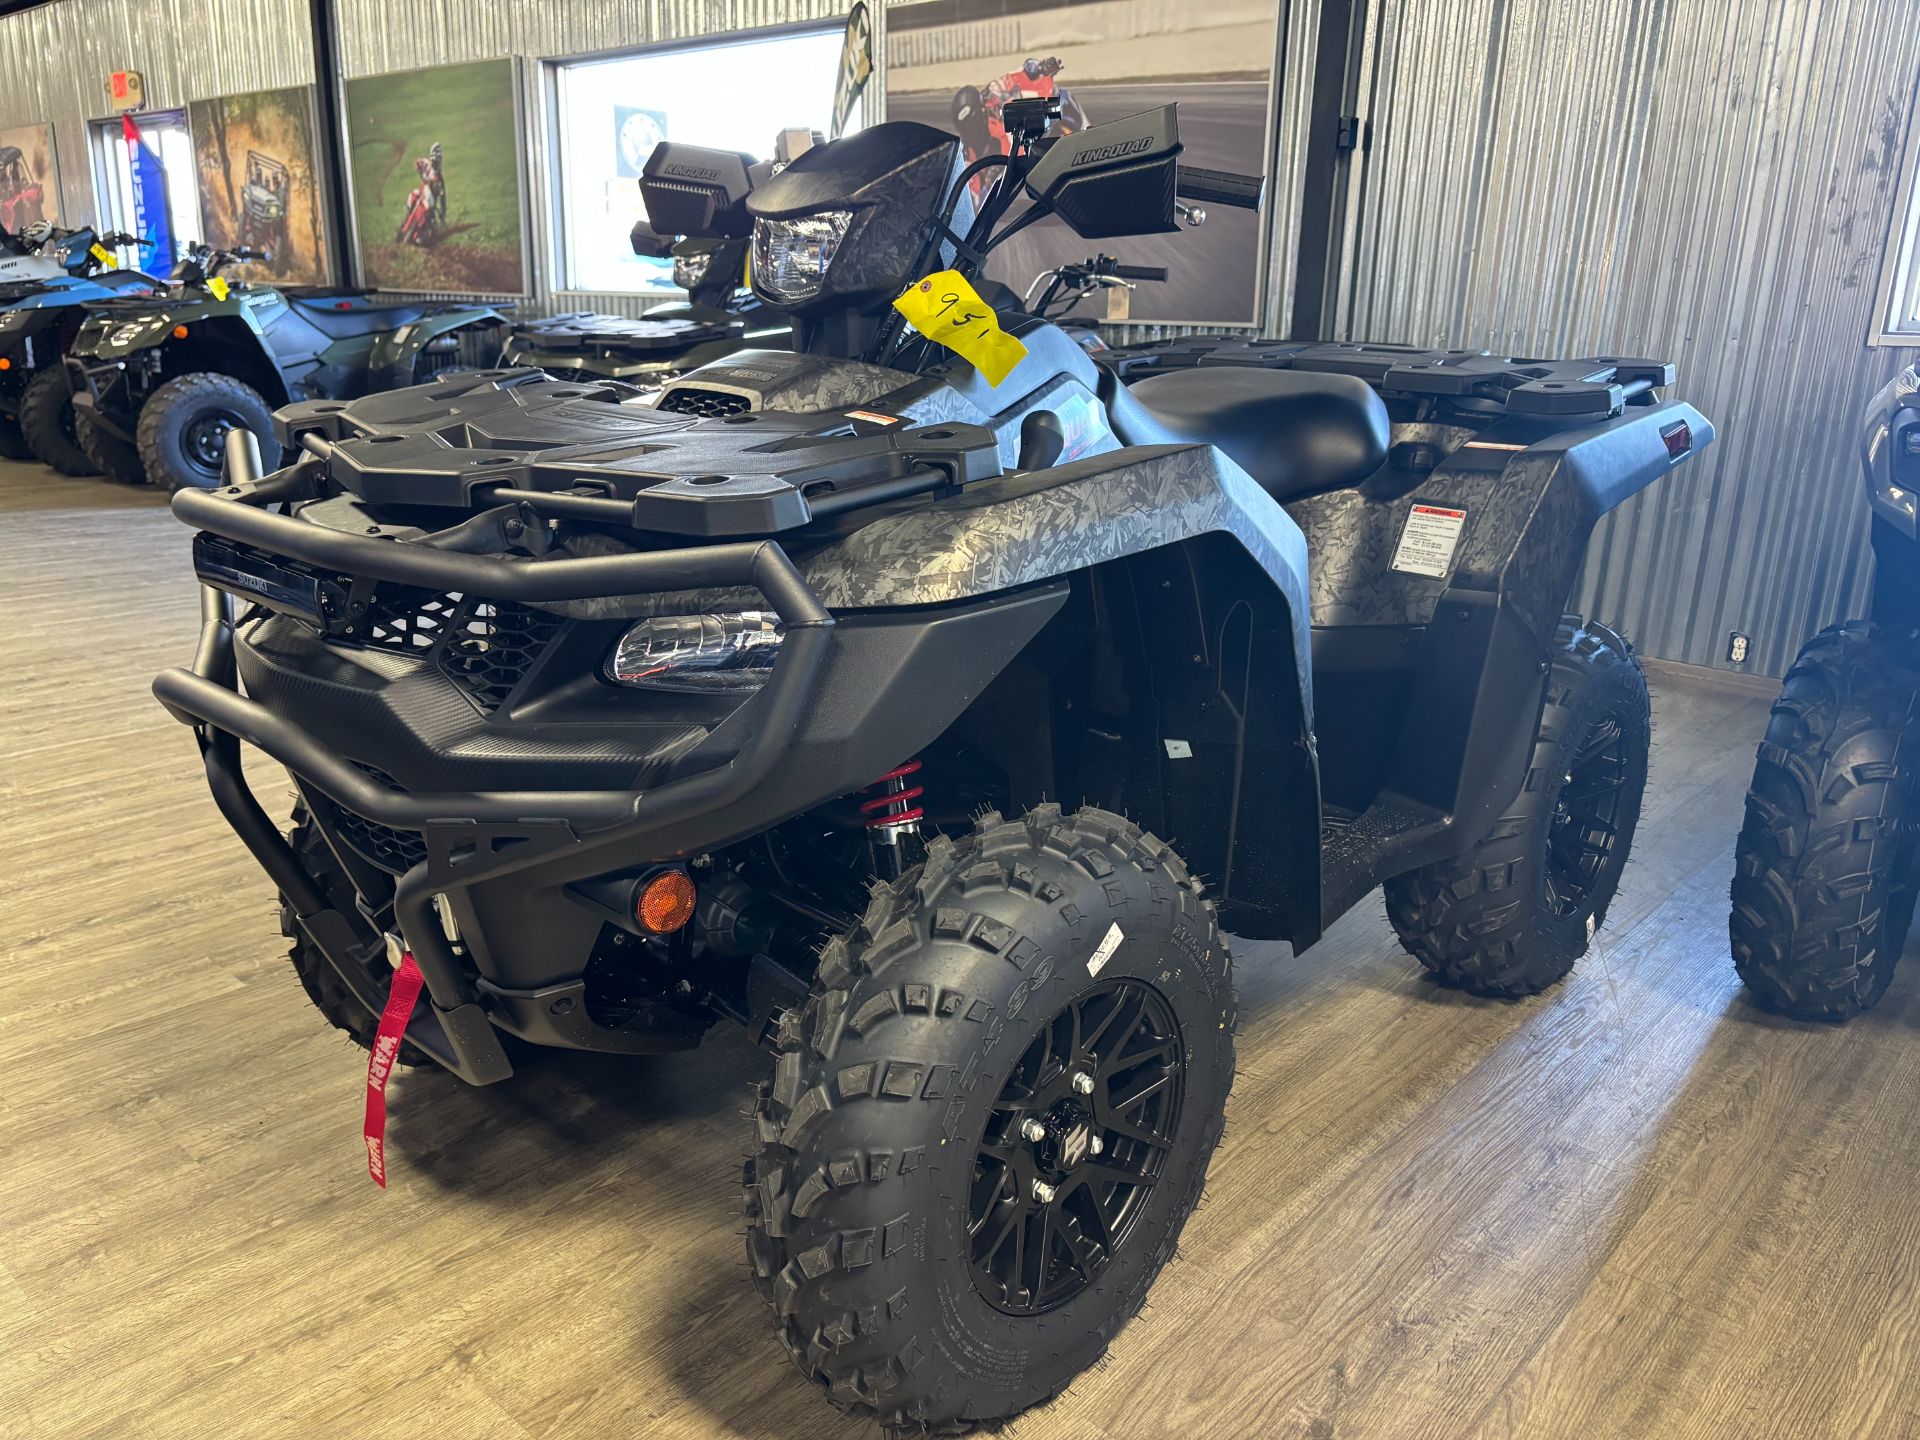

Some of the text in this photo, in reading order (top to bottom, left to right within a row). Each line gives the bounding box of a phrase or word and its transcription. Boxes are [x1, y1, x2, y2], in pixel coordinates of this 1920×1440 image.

[1071, 136, 1154, 166] KINGQUAD
[664, 164, 721, 181] KINGQUAD
[237, 571, 268, 592] SUZUKI
[368, 1034, 399, 1092] WARN
[365, 1135, 384, 1179] WARN
